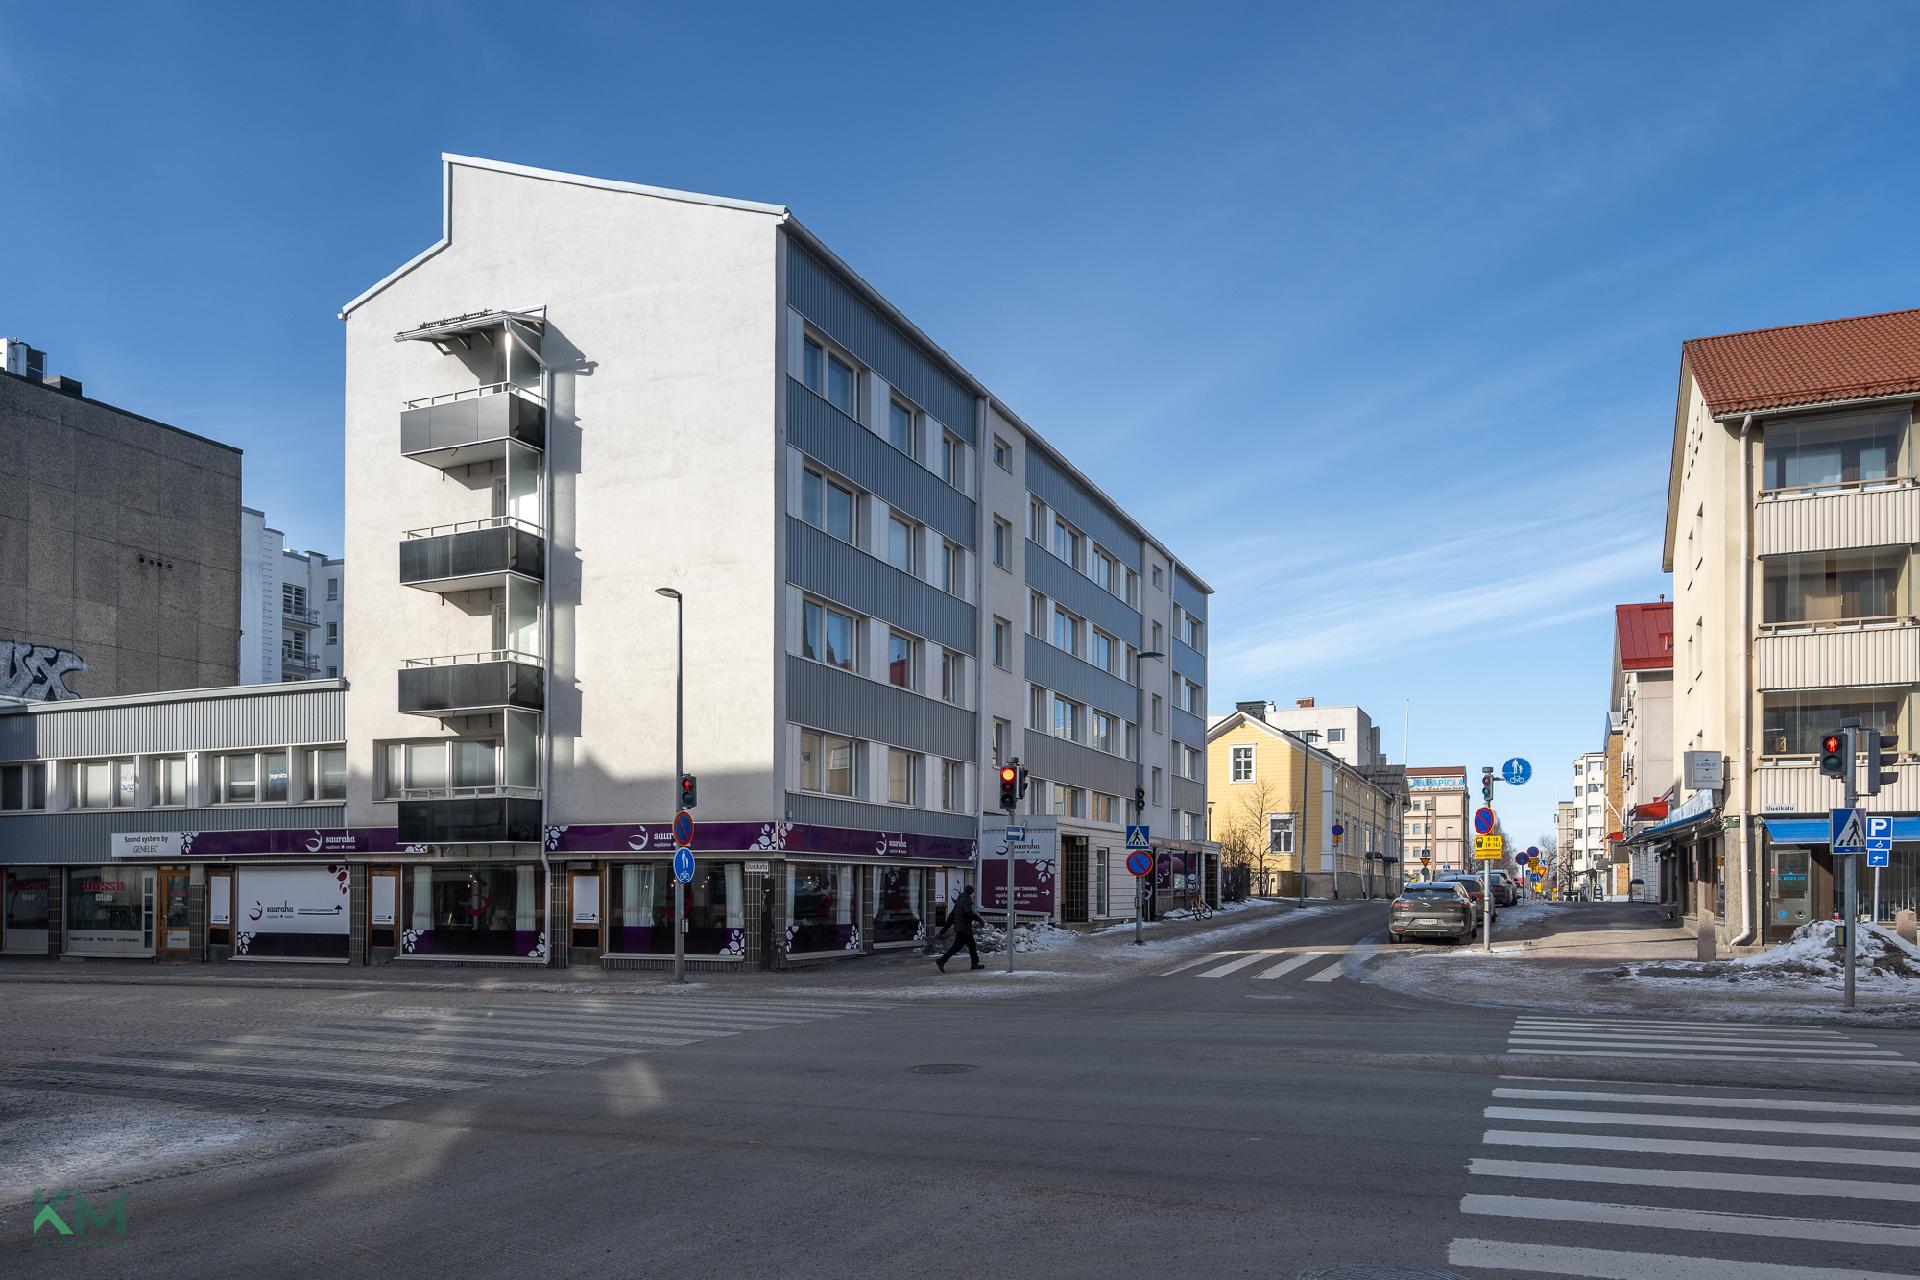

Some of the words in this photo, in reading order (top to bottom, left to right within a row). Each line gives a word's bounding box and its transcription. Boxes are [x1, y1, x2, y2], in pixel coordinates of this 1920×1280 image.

[1871, 818, 1887, 837] P
[142, 836, 160, 844] system
[161, 835, 168, 843] by
[325, 830, 356, 843] sauraha
[654, 832, 674, 840] saur
[267, 900, 294, 912] sauraha
